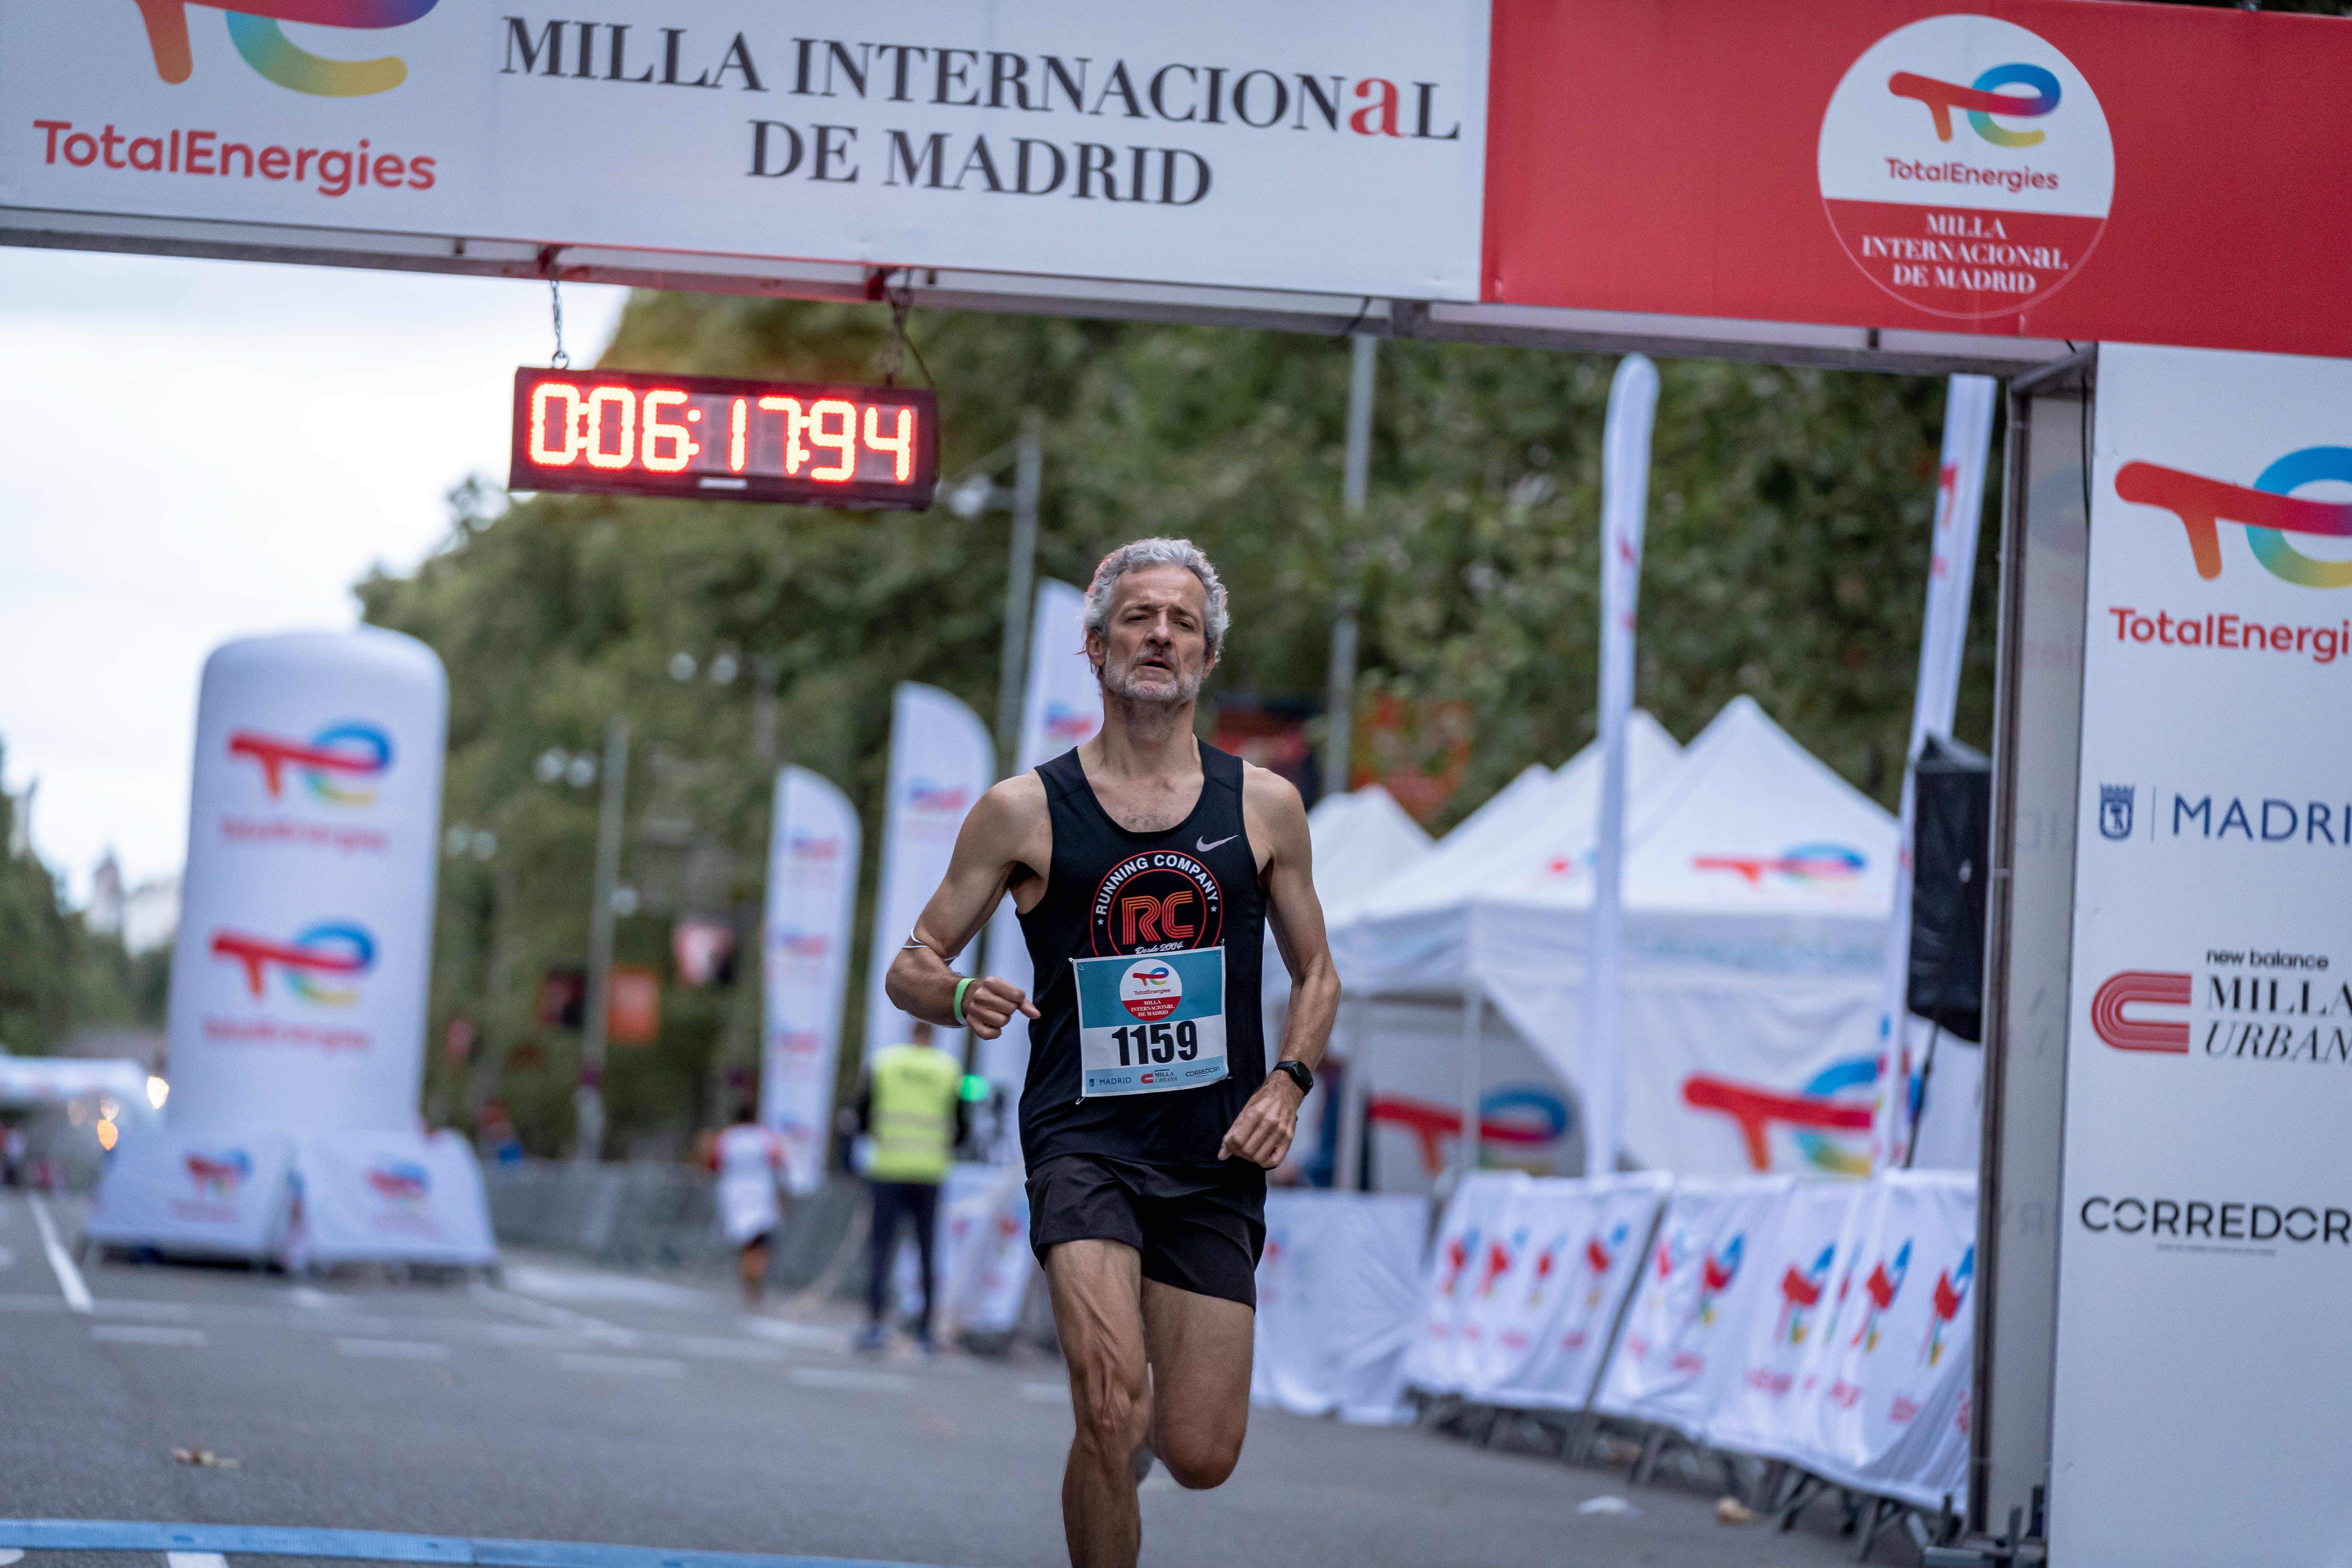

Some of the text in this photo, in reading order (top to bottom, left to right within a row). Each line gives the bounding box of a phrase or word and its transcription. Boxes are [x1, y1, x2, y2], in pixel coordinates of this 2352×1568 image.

[499, 16, 769, 93] MILLA
[33, 119, 436, 197] TotalEnergies
[746, 119, 1213, 207] DE MADRID
[1886, 158, 2059, 193] TotalEnergies
[1926, 214, 2007, 240] MILLA
[1893, 263, 2036, 294] DE MADRID
[2174, 793, 2352, 846] MADRI
[1096, 855, 1218, 915] RUNNING COMPANY
[1122, 891, 1194, 945] RC
[1135, 941, 1184, 954] Desde 2004
[2206, 948, 2329, 971] new balance
[2208, 974, 2352, 1016] MILLA
[1111, 1020, 1198, 1066] 1159
[2081, 1196, 2352, 1244] CORREDOR
